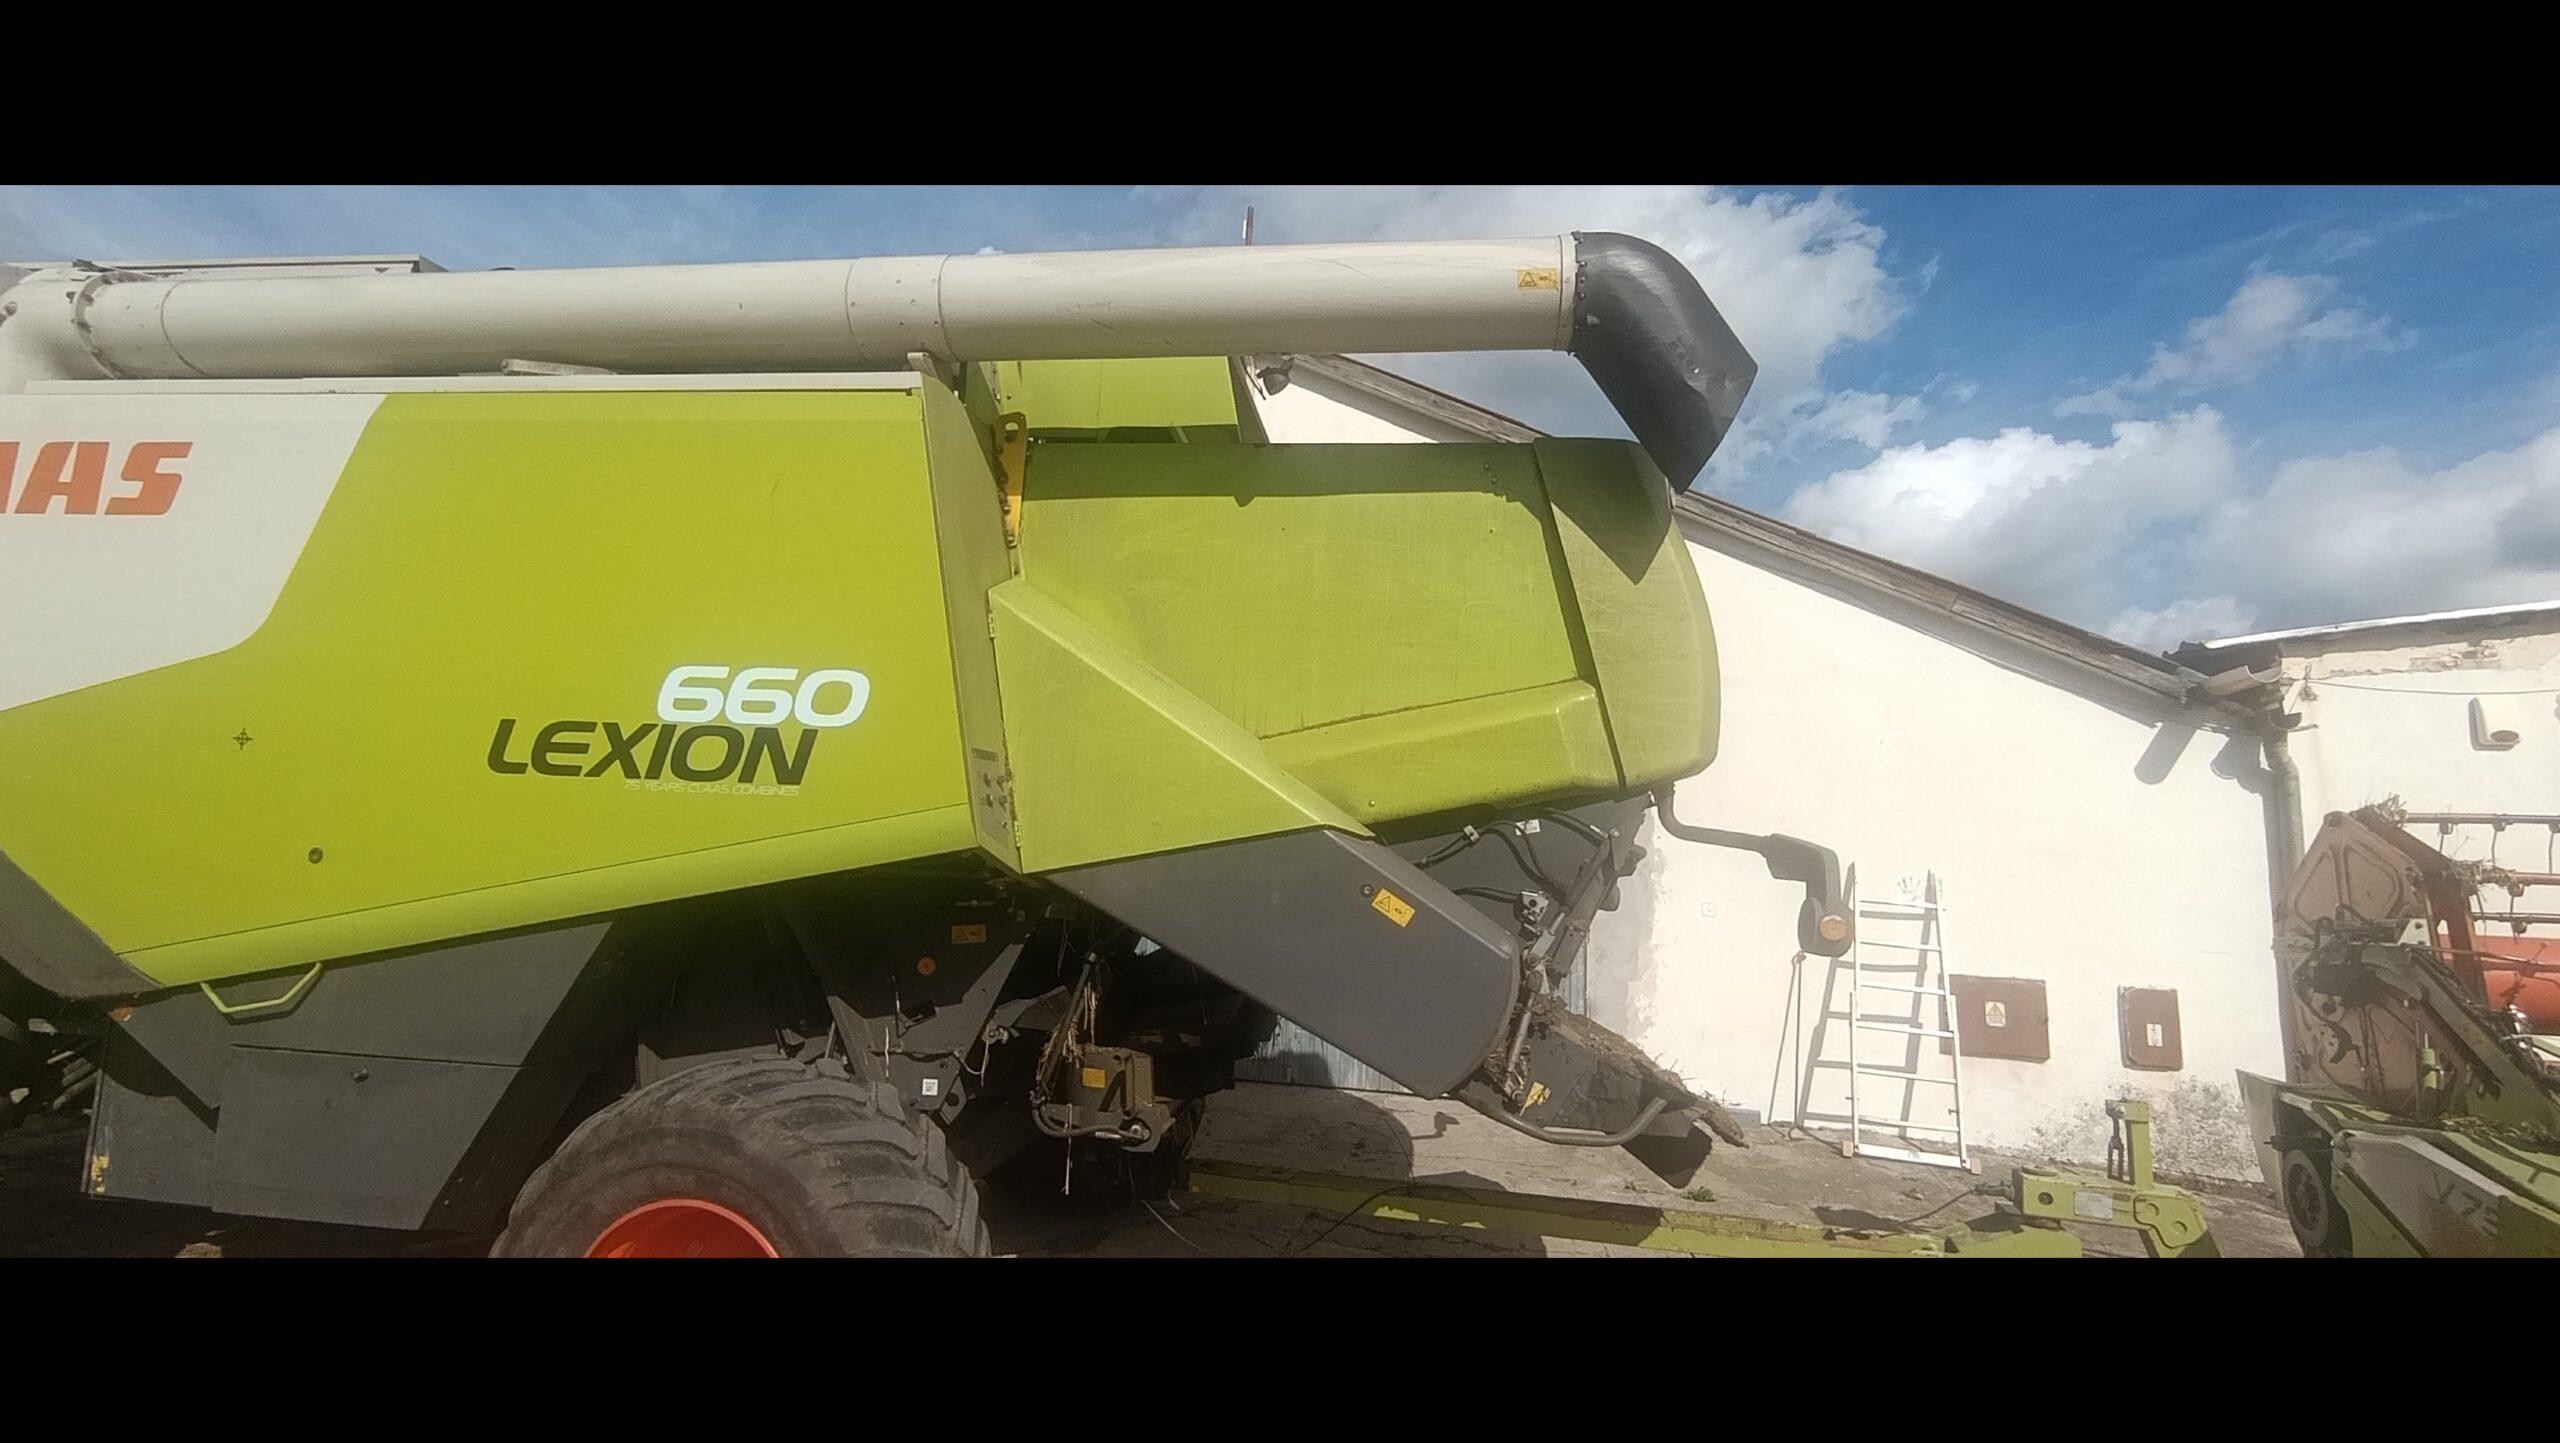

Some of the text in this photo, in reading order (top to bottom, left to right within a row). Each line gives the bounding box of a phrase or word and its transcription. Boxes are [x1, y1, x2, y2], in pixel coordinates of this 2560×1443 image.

[0, 441, 193, 515] AS
[656, 664, 871, 728] 660
[486, 718, 819, 786] LEXION
[643, 781, 685, 793] YEARS
[687, 783, 730, 794] CLAAS
[732, 784, 800, 797] COMBINES
